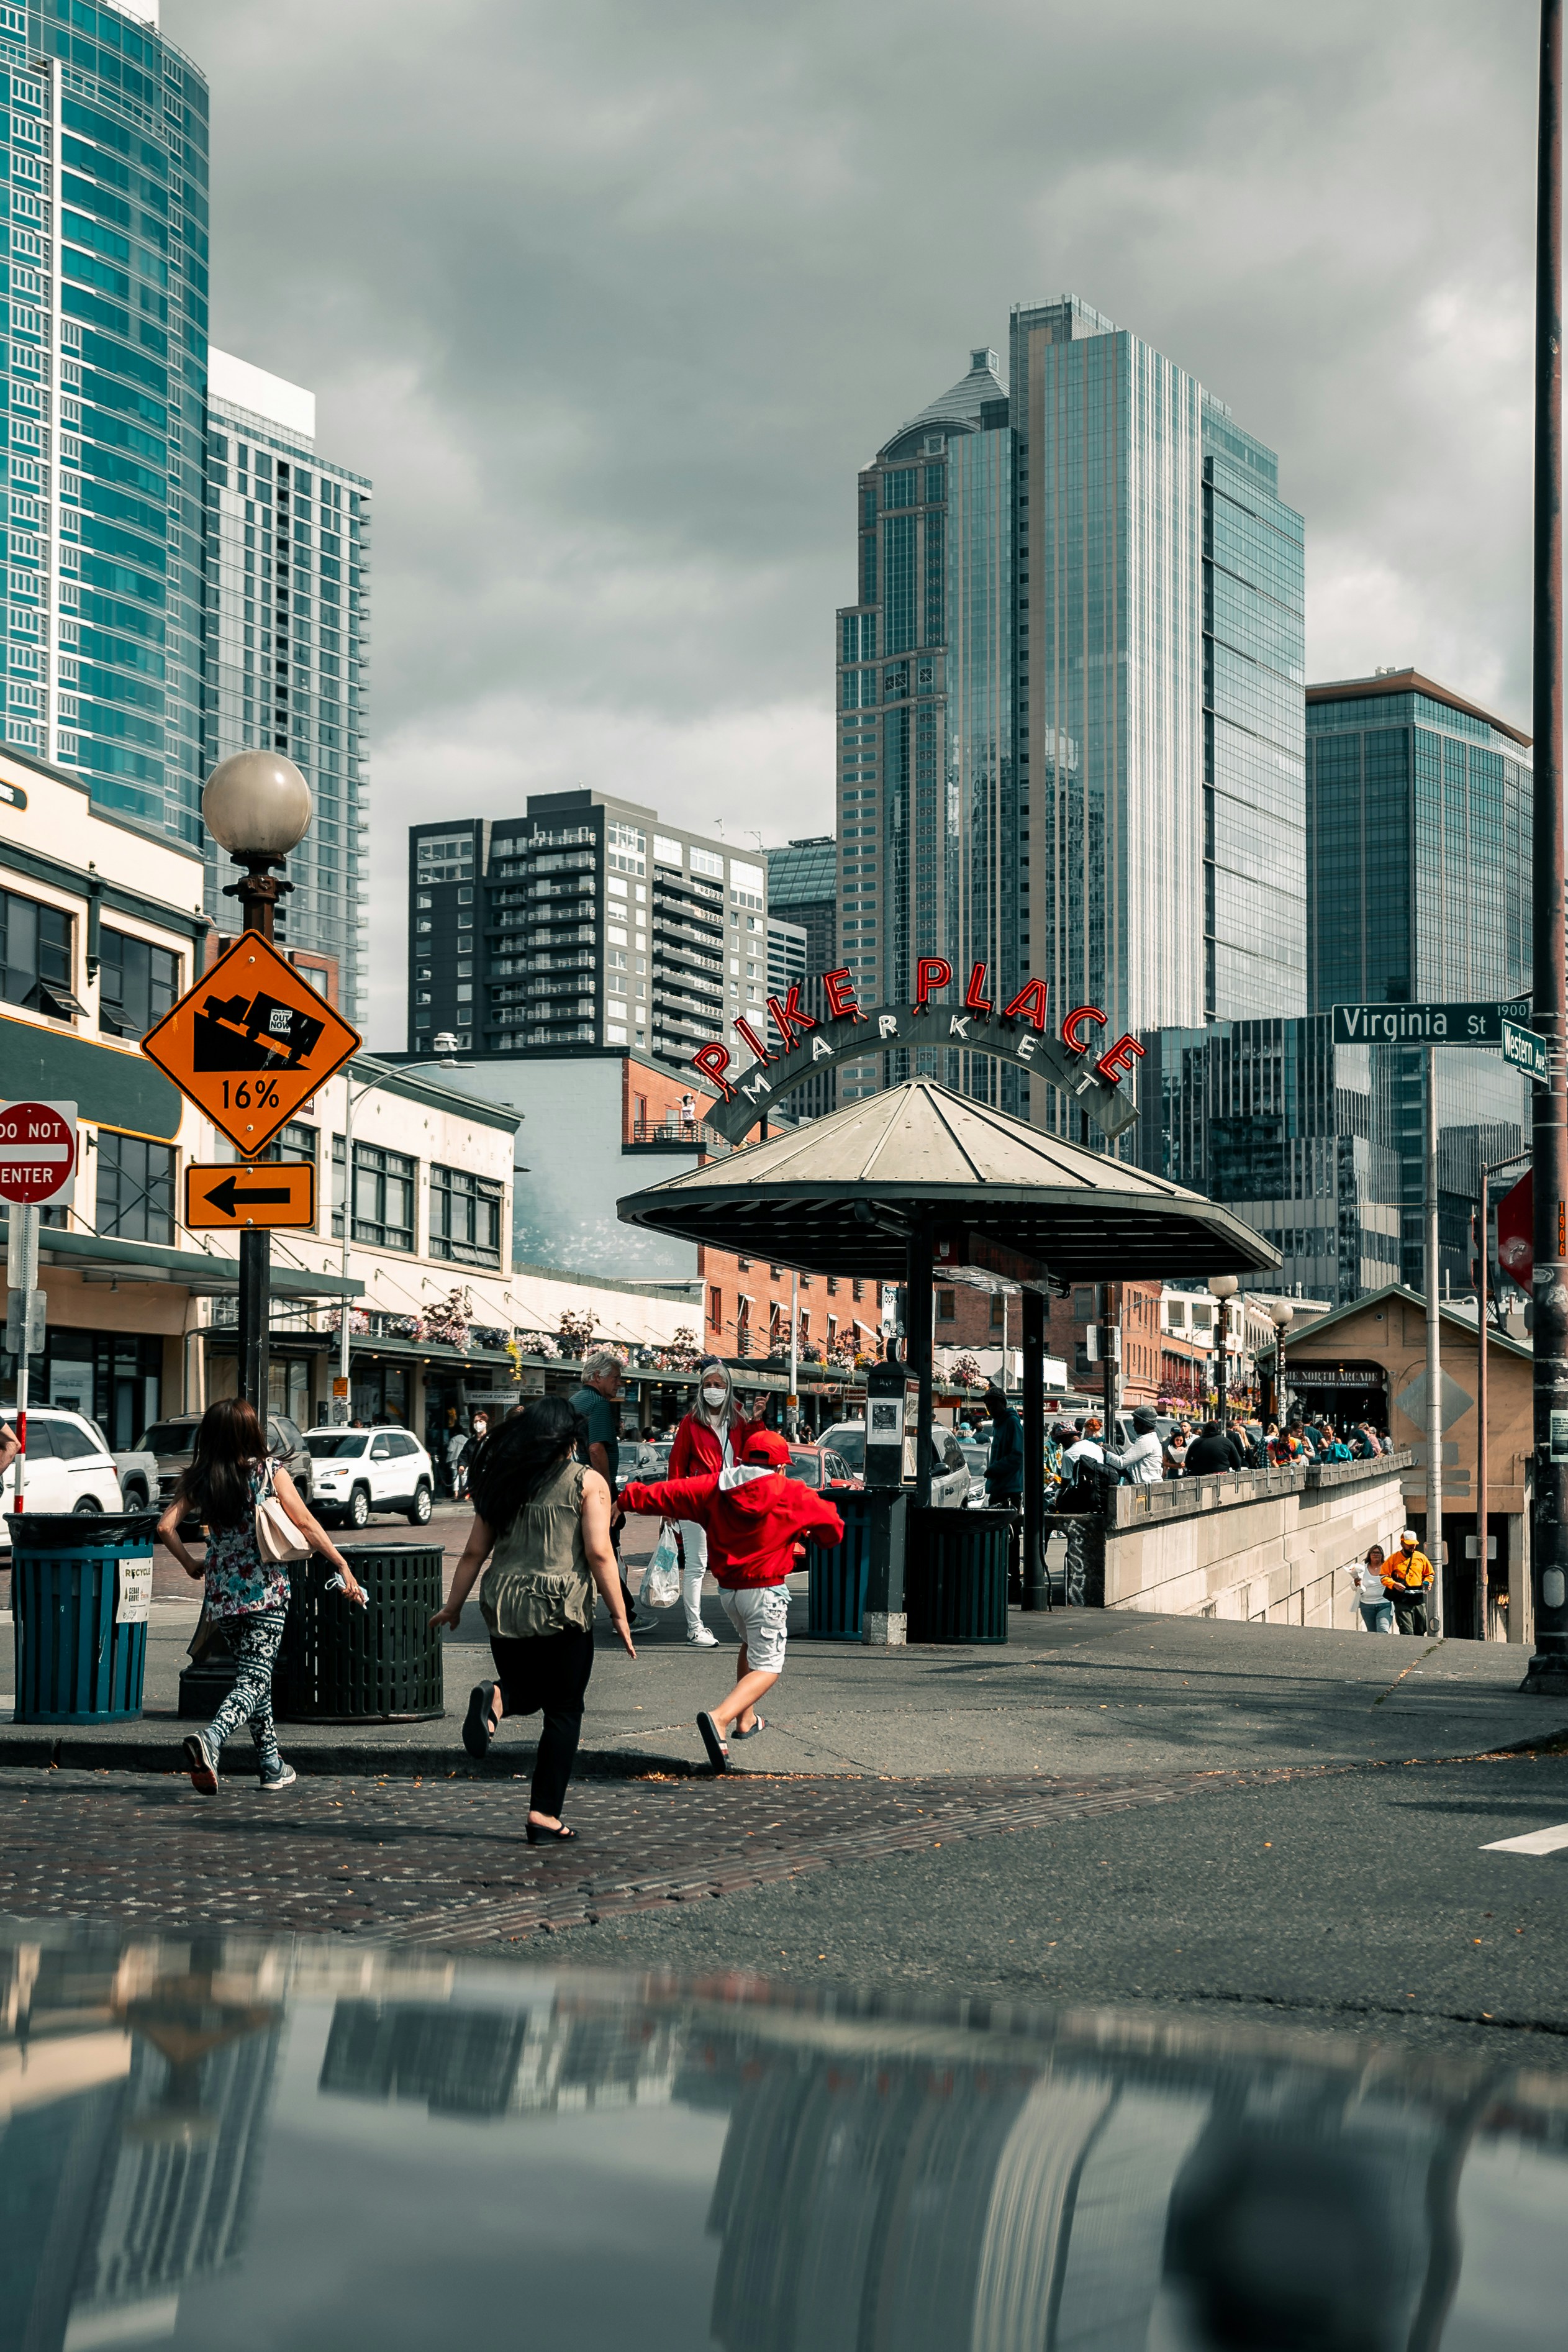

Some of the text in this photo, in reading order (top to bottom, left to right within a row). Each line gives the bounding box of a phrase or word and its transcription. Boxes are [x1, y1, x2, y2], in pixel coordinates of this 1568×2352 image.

[1497, 1004, 1526, 1017] 1900
[271, 1021, 289, 1029] NOW
[691, 956, 1148, 1091] PIKE PLACE
[1343, 1006, 1487, 1042] Virginia St
[1504, 1024, 1546, 1071] Western Ave
[742, 1014, 1100, 1105] MARKET
[222, 1079, 279, 1109] 16%
[0, 1122, 61, 1138] DO NOT
[1, 1168, 53, 1183] ENTER
[1285, 1371, 1378, 1382] HE NORTH ARCADE
